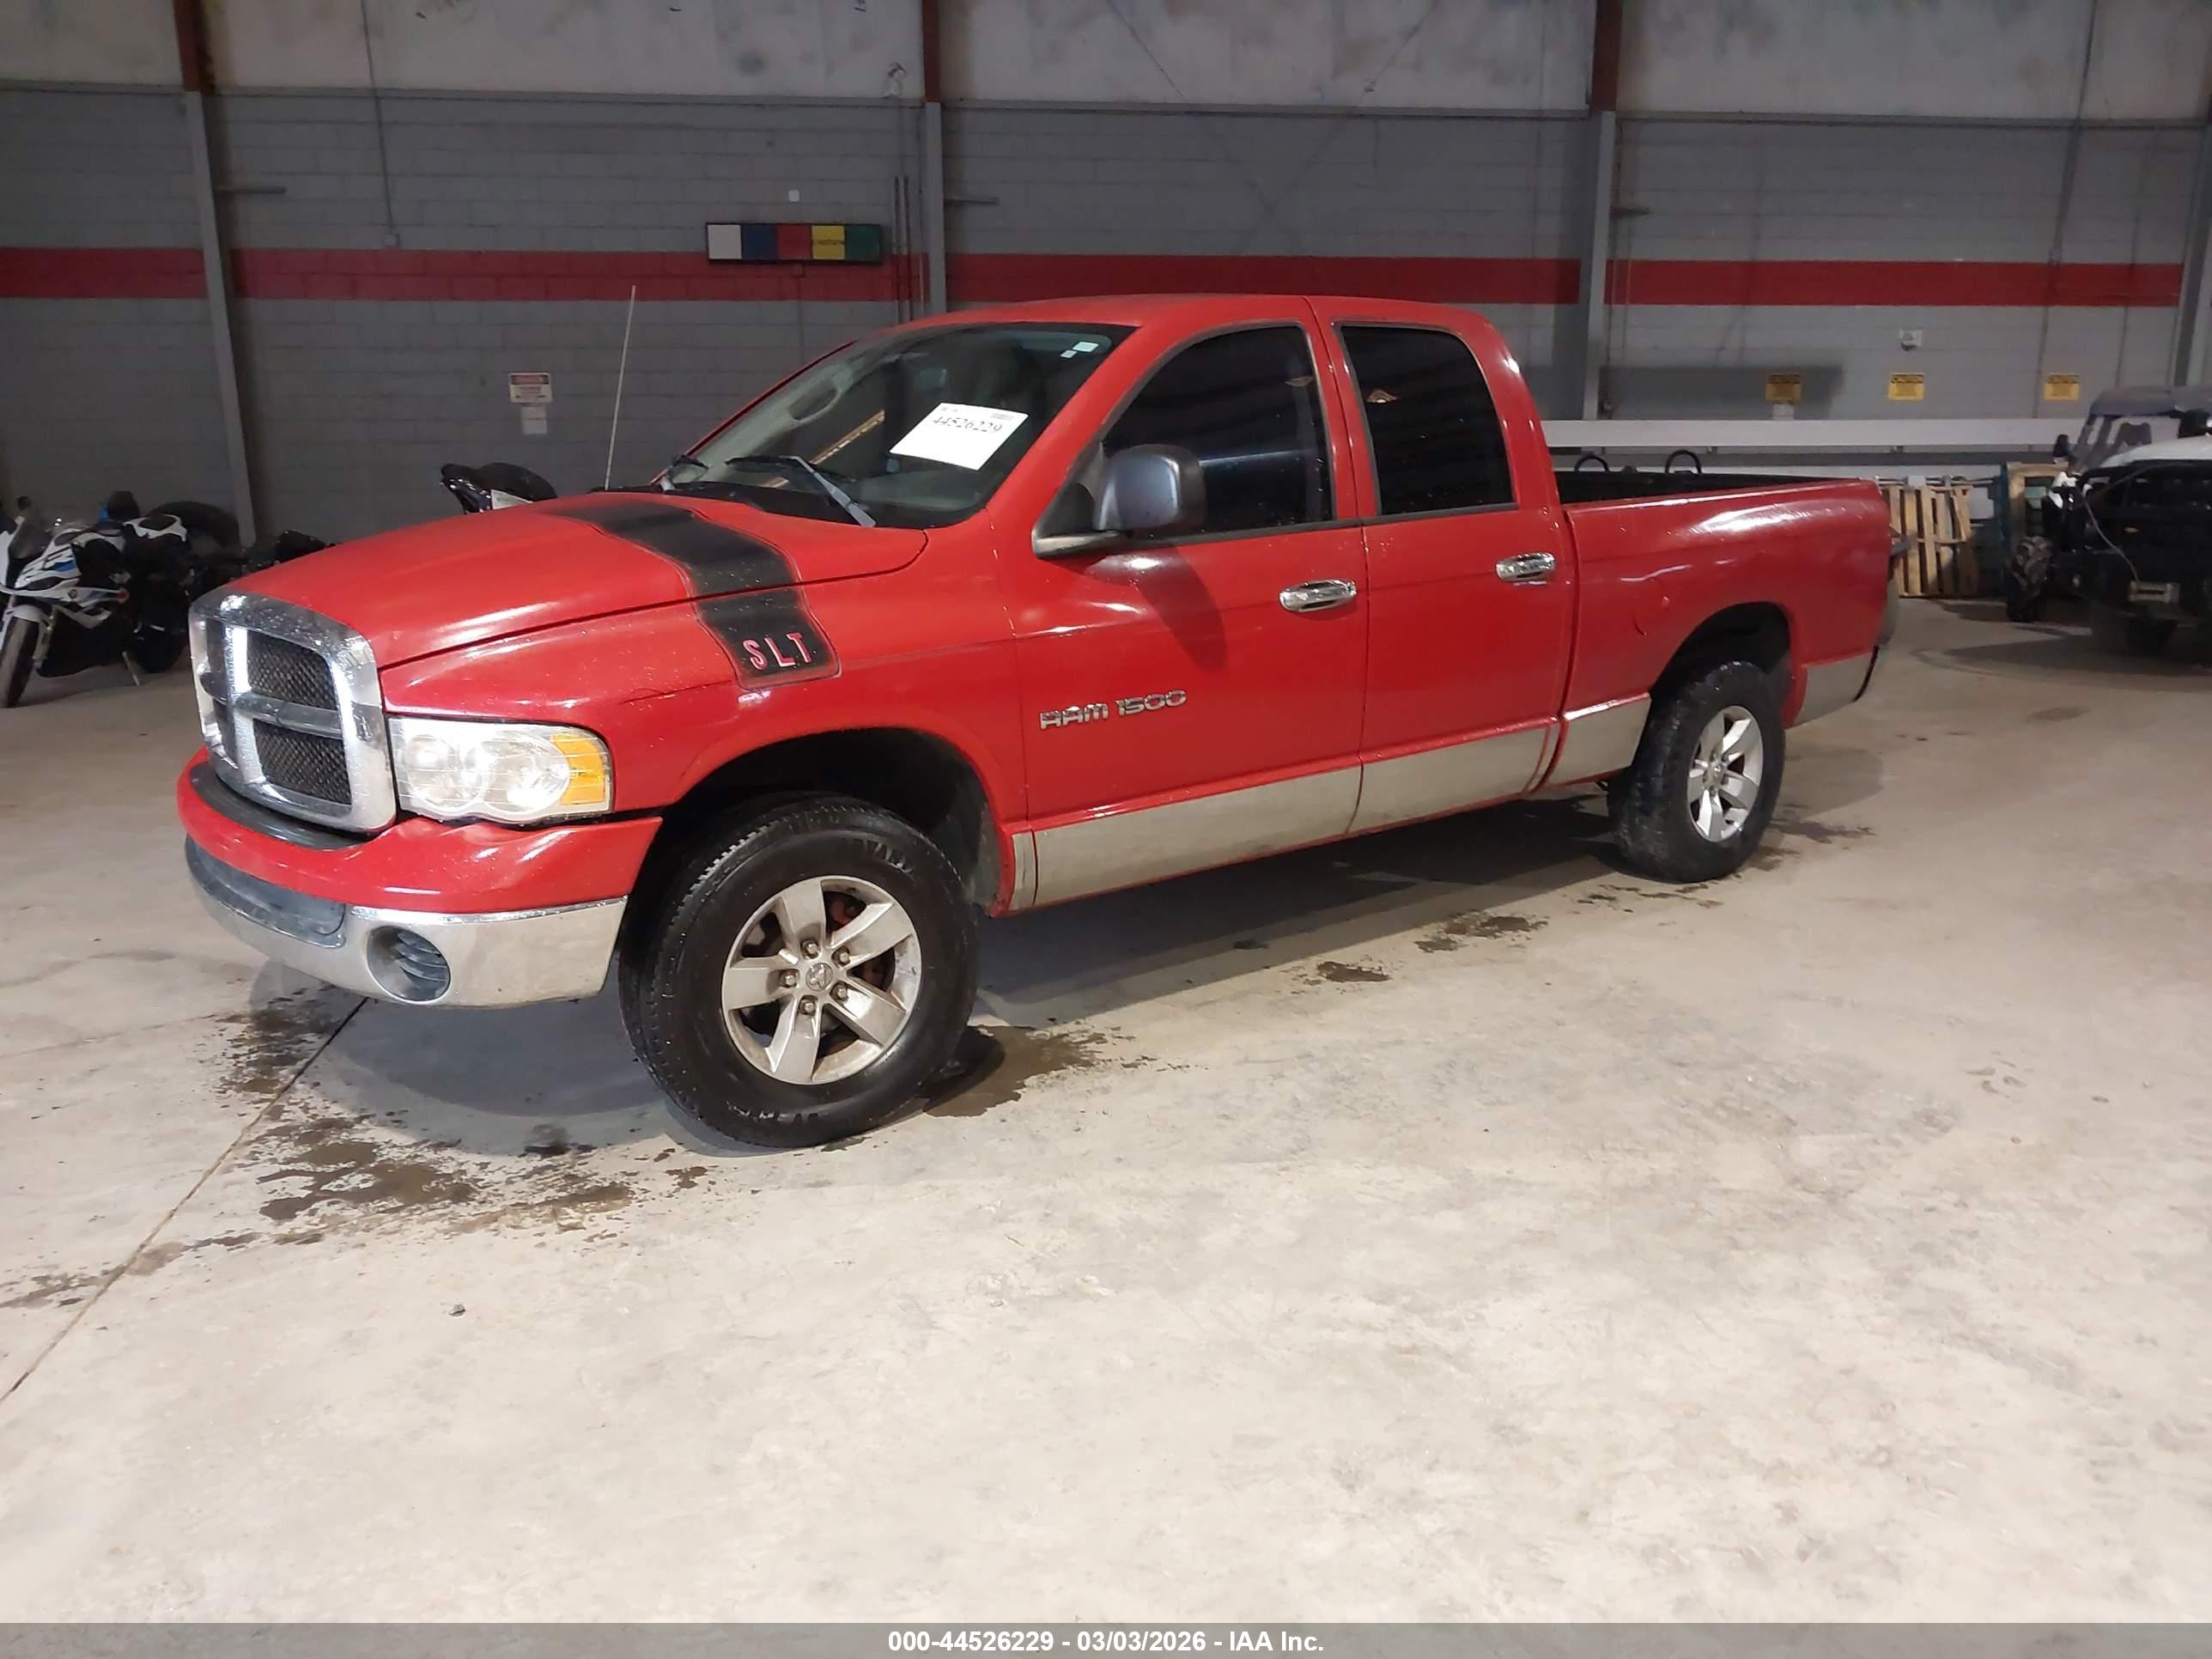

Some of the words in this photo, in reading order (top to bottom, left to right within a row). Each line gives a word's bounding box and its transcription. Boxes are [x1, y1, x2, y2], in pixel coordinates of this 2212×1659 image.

[742, 632, 812, 670] SLT
[1040, 703, 1109, 730] RAM
[1115, 690, 1188, 716] 1500
